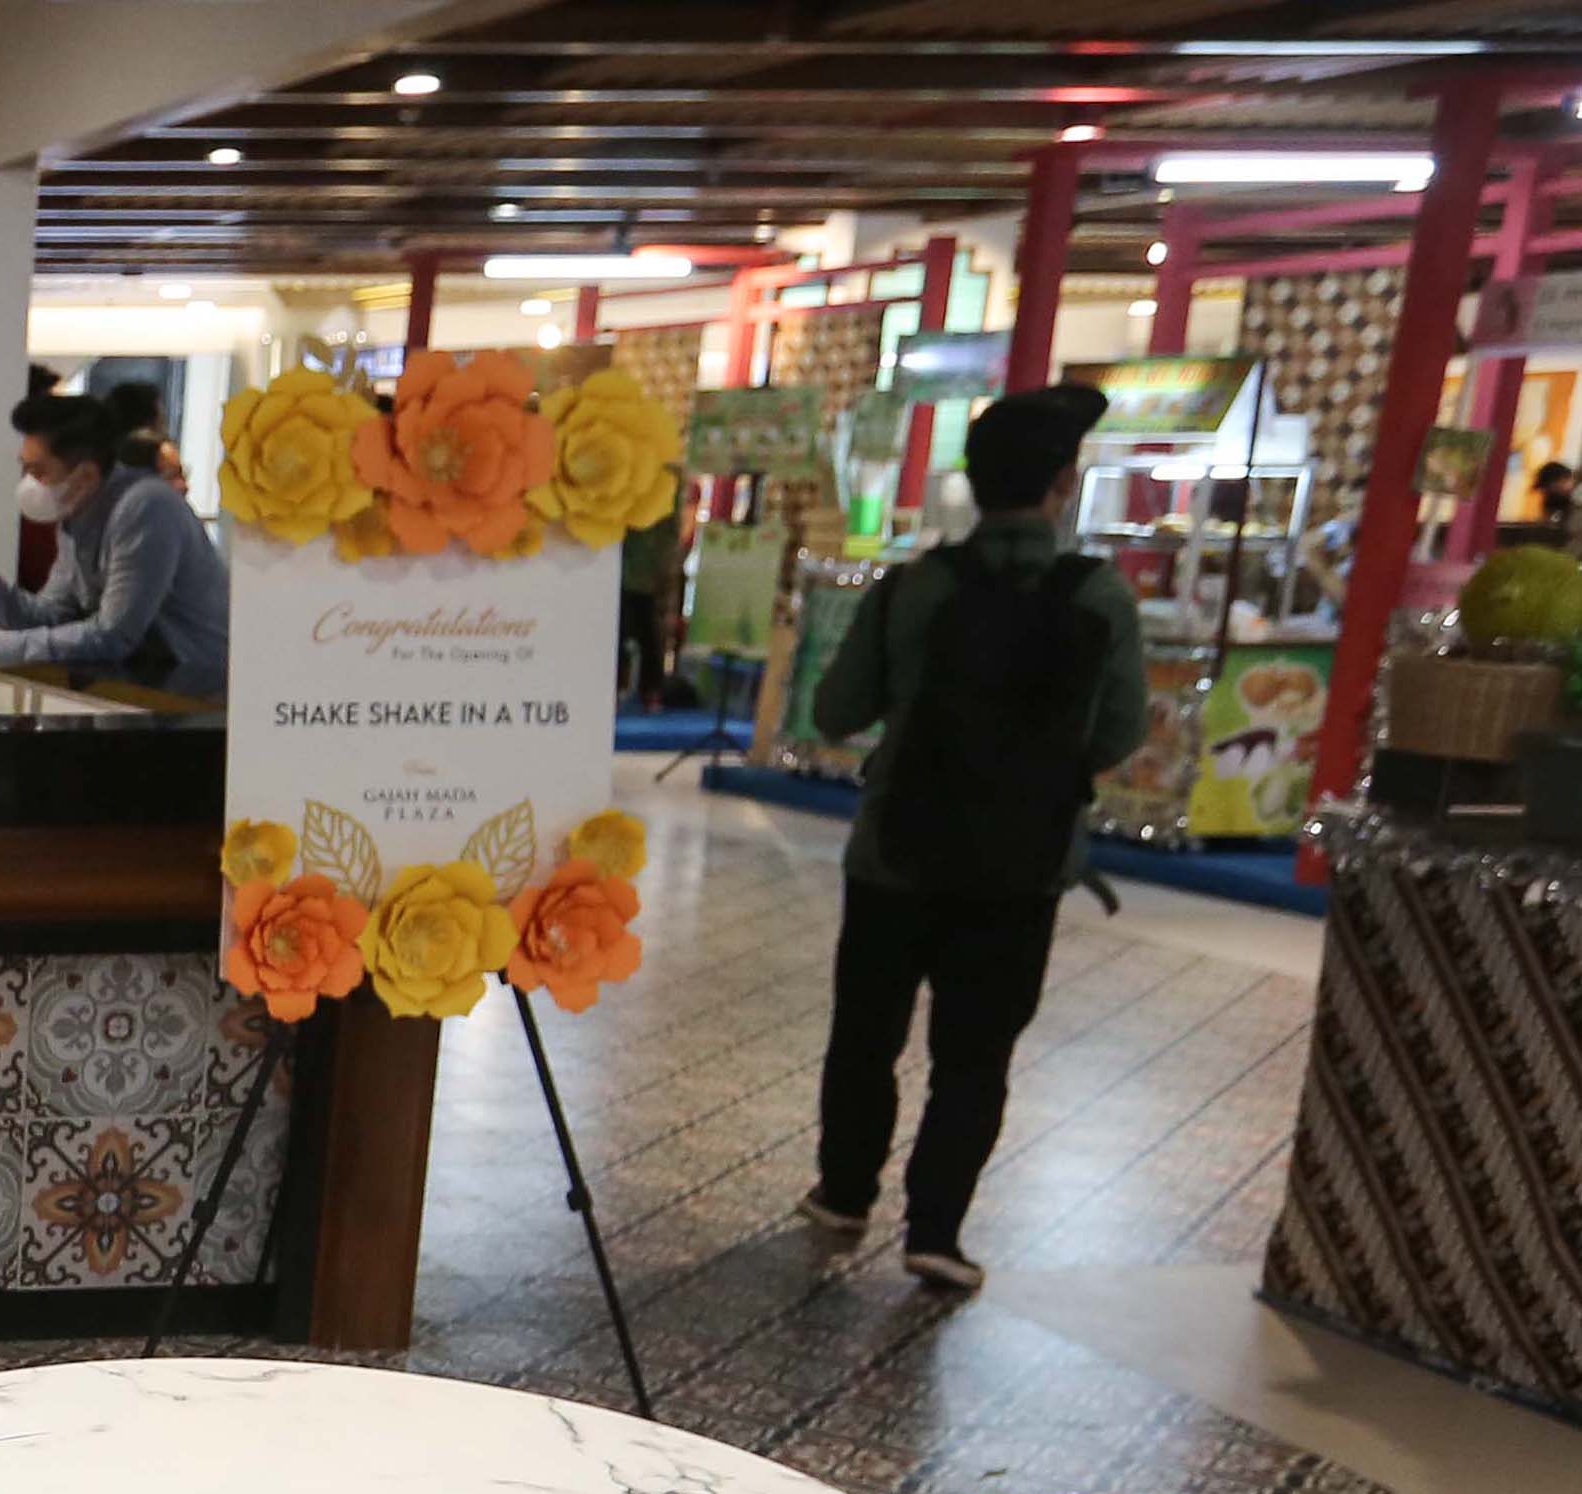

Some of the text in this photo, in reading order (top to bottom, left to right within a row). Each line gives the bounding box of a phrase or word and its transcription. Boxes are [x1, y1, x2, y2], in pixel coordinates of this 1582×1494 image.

[312, 602, 537, 655] Congratulations
[274, 701, 570, 726] SHAKE SHAKE IN A TUB
[384, 806, 455, 821] PLAZA
